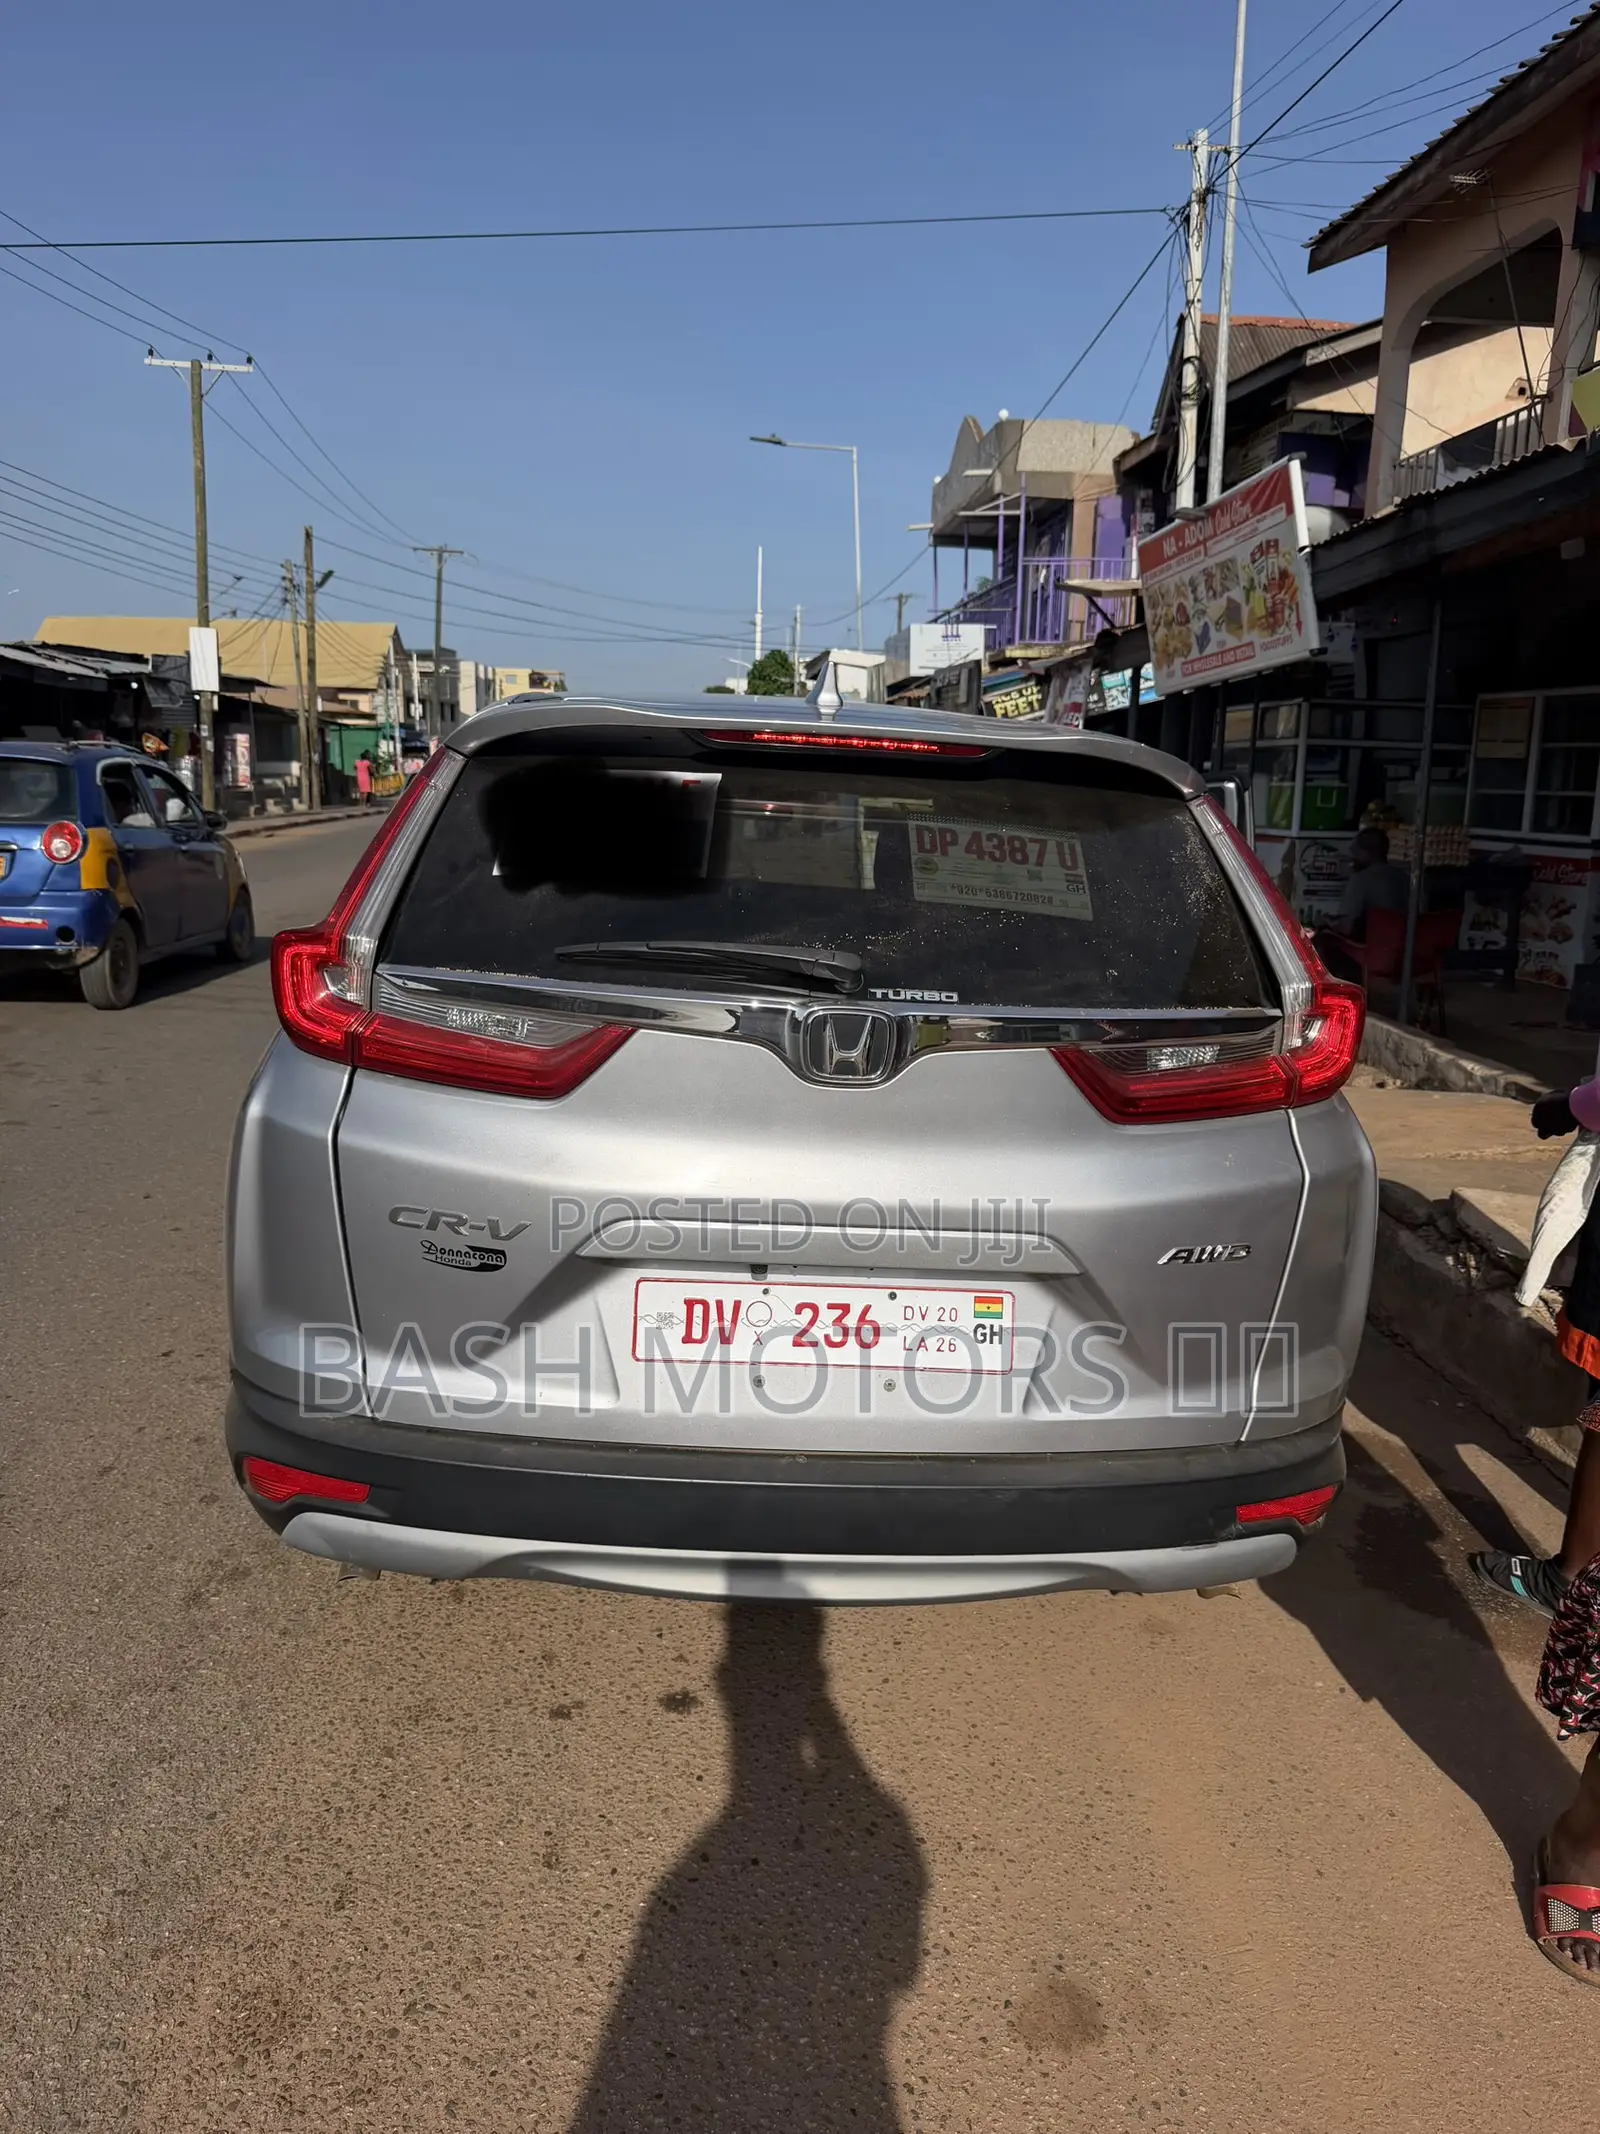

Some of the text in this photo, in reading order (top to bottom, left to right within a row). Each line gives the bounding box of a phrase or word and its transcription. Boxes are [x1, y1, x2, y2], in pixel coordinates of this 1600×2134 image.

[1184, 517, 1214, 548] ADOM
[993, 693, 1042, 720] FEET
[915, 824, 1079, 871] DP 4387 U
[1066, 883, 1087, 895] GH
[869, 989, 958, 1002] TURBO
[389, 1204, 533, 1241] CR-V
[420, 1239, 504, 1264] Donnacona
[435, 1254, 472, 1266] Honda
[1157, 1243, 1252, 1265] AWD
[682, 1297, 881, 1349] DV 236
[903, 1305, 959, 1323] DV 20
[903, 1335, 957, 1353] LA 26
[973, 1323, 1004, 1346] GH
